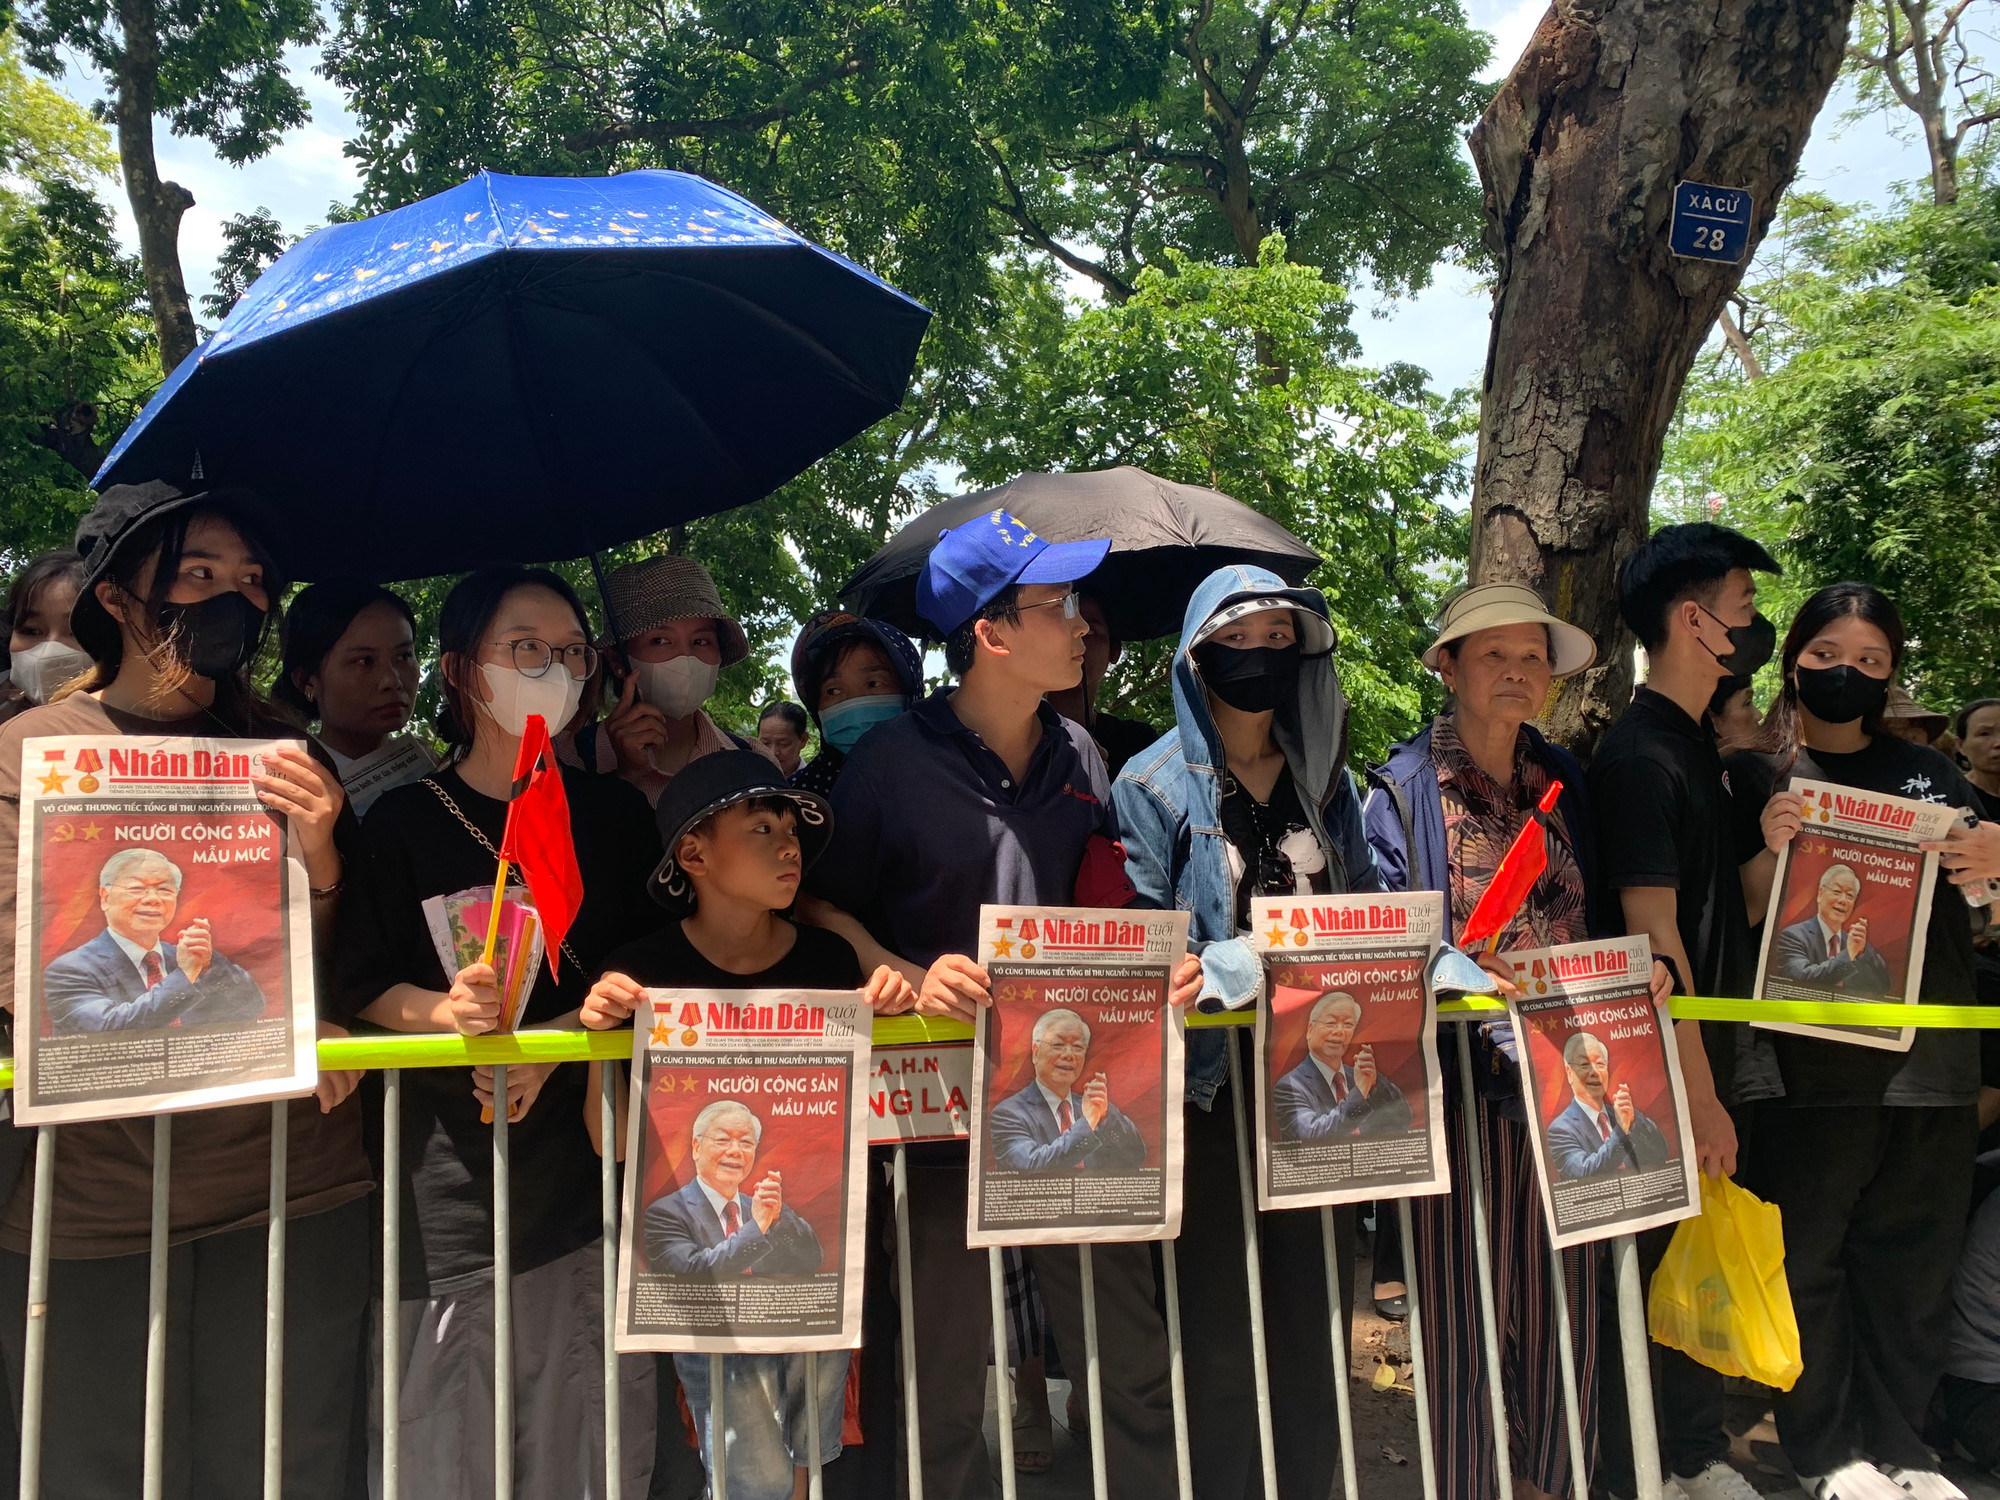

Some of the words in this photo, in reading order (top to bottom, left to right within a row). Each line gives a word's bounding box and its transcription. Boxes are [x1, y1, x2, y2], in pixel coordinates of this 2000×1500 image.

[1689, 190, 1712, 210] XÀ
[1716, 194, 1740, 213] CỪ
[1693, 226, 1725, 251] 28
[108, 749, 189, 776] Nhân
[192, 750, 250, 777] Dân
[43, 804, 55, 813] VÔ
[58, 803, 83, 812] CÙNG
[86, 803, 121, 811] THƯƠNG
[124, 802, 142, 811] TIẾC
[143, 802, 166, 811] TỔNG
[169, 802, 177, 811] BÍ
[198, 802, 231, 812] NGUYỄN
[1835, 794, 1878, 820] Nhân
[1880, 803, 1915, 826] Dân
[114, 822, 176, 840] NGƯỜI
[180, 822, 233, 843] CỘNG
[237, 820, 271, 839] SẢN
[192, 844, 230, 863] MẪU
[234, 846, 271, 863] MỰC
[1833, 848, 1862, 863] NGƯỜI
[1864, 853, 1892, 868] CỘNG
[1895, 858, 1915, 872] SẢN
[1312, 906, 1365, 930] Nhân
[1369, 905, 1406, 929] Dân
[1408, 903, 1430, 917] cuối
[1043, 918, 1100, 944] Nhân
[1104, 920, 1145, 945] Dân
[1148, 921, 1174, 936] cuối
[1408, 919, 1430, 933] tuần
[1146, 937, 1172, 952] tuần
[995, 967, 1003, 975] VÔ
[1005, 967, 1023, 975] CÙNG
[1052, 967, 1065, 975] TIẾC
[1066, 967, 1082, 975] TỔNG
[1085, 967, 1090, 976] BÍ
[1105, 967, 1129, 976] NGUYỄN
[1548, 954, 1592, 978] Nhân
[1595, 950, 1628, 972] Dân
[1322, 970, 1360, 985] NGƯỜI
[1364, 969, 1397, 986] CỘNG
[1401, 966, 1420, 982] SẢN
[1045, 985, 1088, 1002] NGƯỜI
[1092, 985, 1129, 1004] CỘNG
[1132, 985, 1156, 1002] SẢN
[1370, 987, 1394, 1002] MẪU
[1397, 988, 1419, 1002] MỰC
[707, 1002, 773, 1030] Nhân
[777, 1003, 824, 1030] Dân
[828, 1003, 857, 1018] cuối
[1098, 1006, 1125, 1022] MẪU
[1128, 1009, 1154, 1024] MỰC
[1564, 1011, 1598, 1028] NGƯỜI
[1600, 1006, 1628, 1024] CỘNG
[1629, 1002, 1648, 1018] SẢN
[826, 1020, 854, 1036] tuần
[1610, 1024, 1630, 1040] MẪU
[1633, 1023, 1653, 1037] MỰC
[651, 1055, 660, 1064] VÔ
[663, 1055, 683, 1064] CÙNG
[686, 1056, 714, 1064] THƯƠNG
[717, 1055, 732, 1064] TIẾC
[734, 1054, 752, 1064] TỔNG
[755, 1055, 762, 1064] BÍ
[779, 1054, 806, 1064] NGUYỄN
[824, 1057, 846, 1065] TRỌNG
[708, 1075, 759, 1093] NGƯỜI
[764, 1074, 806, 1095] CỘNG
[810, 1073, 838, 1092] SẢN
[772, 1097, 803, 1115] MẪU
[806, 1100, 837, 1117] MỰC
